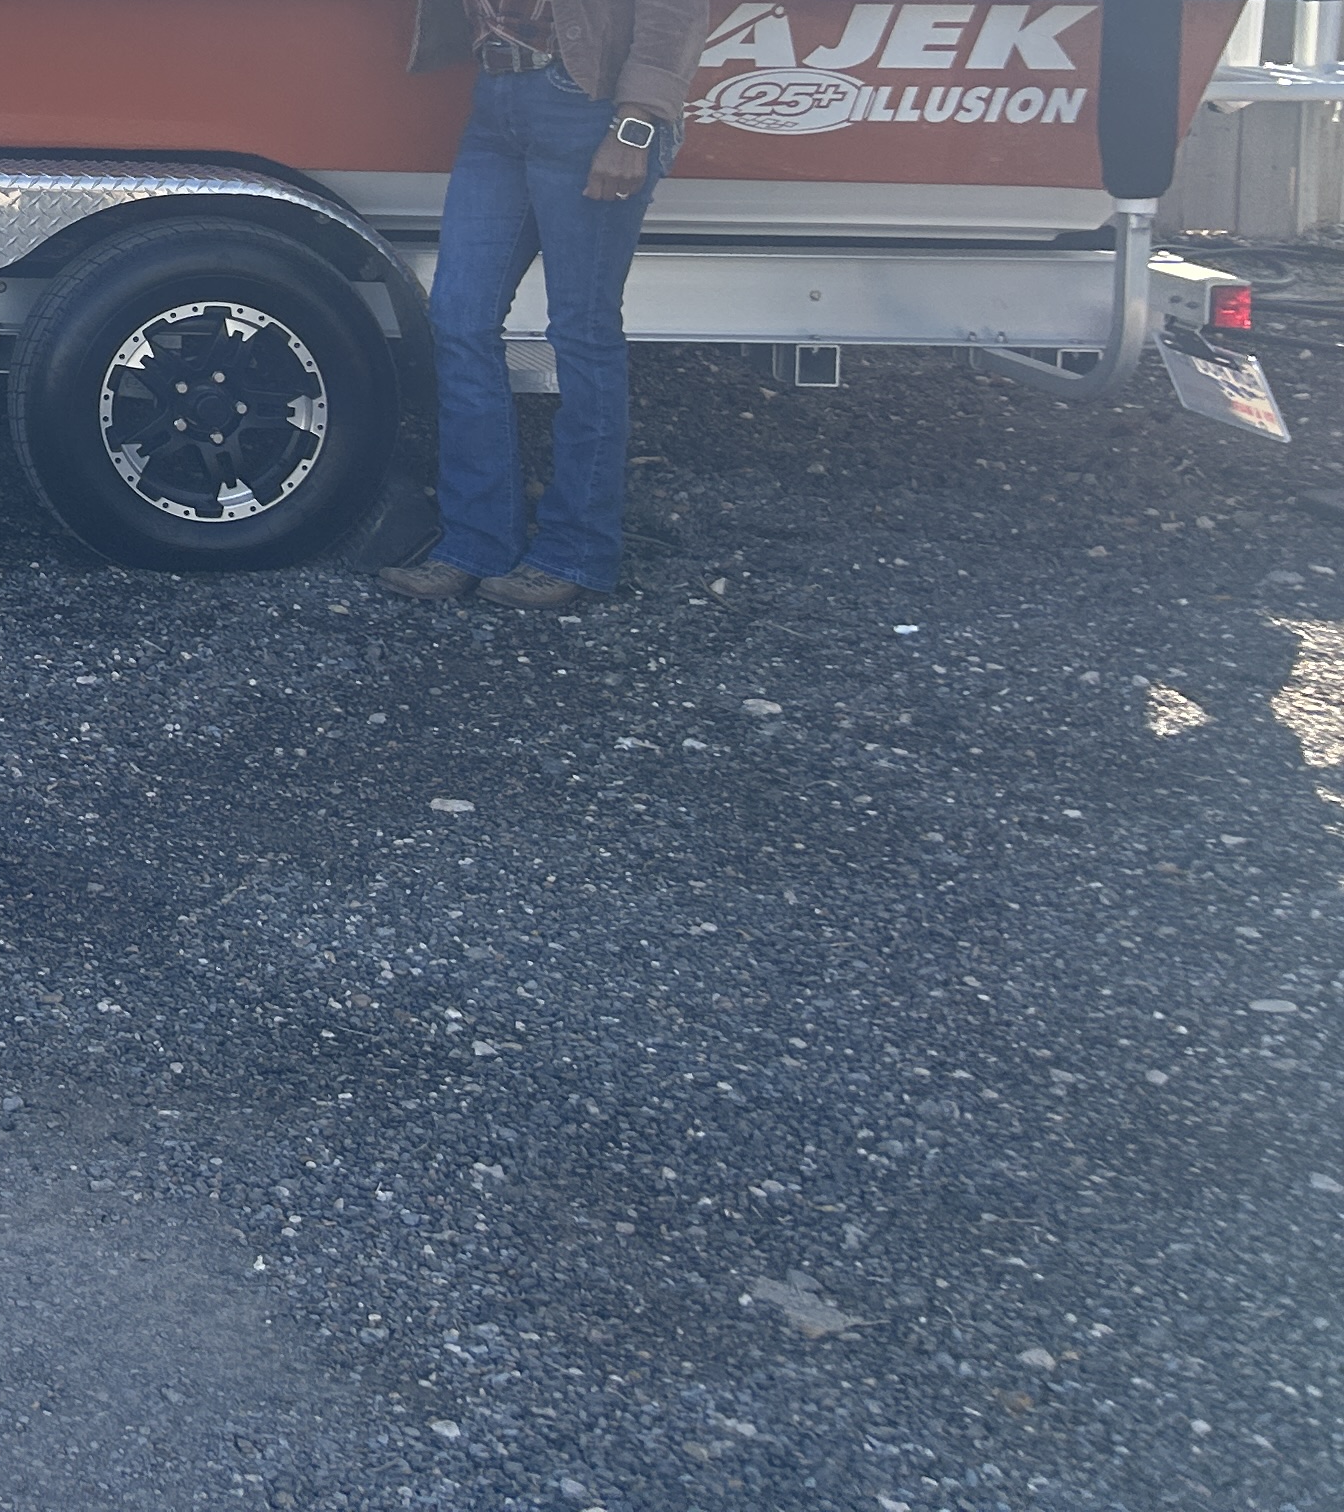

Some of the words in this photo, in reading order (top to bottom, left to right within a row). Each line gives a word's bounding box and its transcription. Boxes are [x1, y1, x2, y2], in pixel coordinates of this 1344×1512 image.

[698, 2, 1100, 71] AJEK
[736, 82, 848, 117] 25+
[850, 85, 1088, 124] ILLUSION
